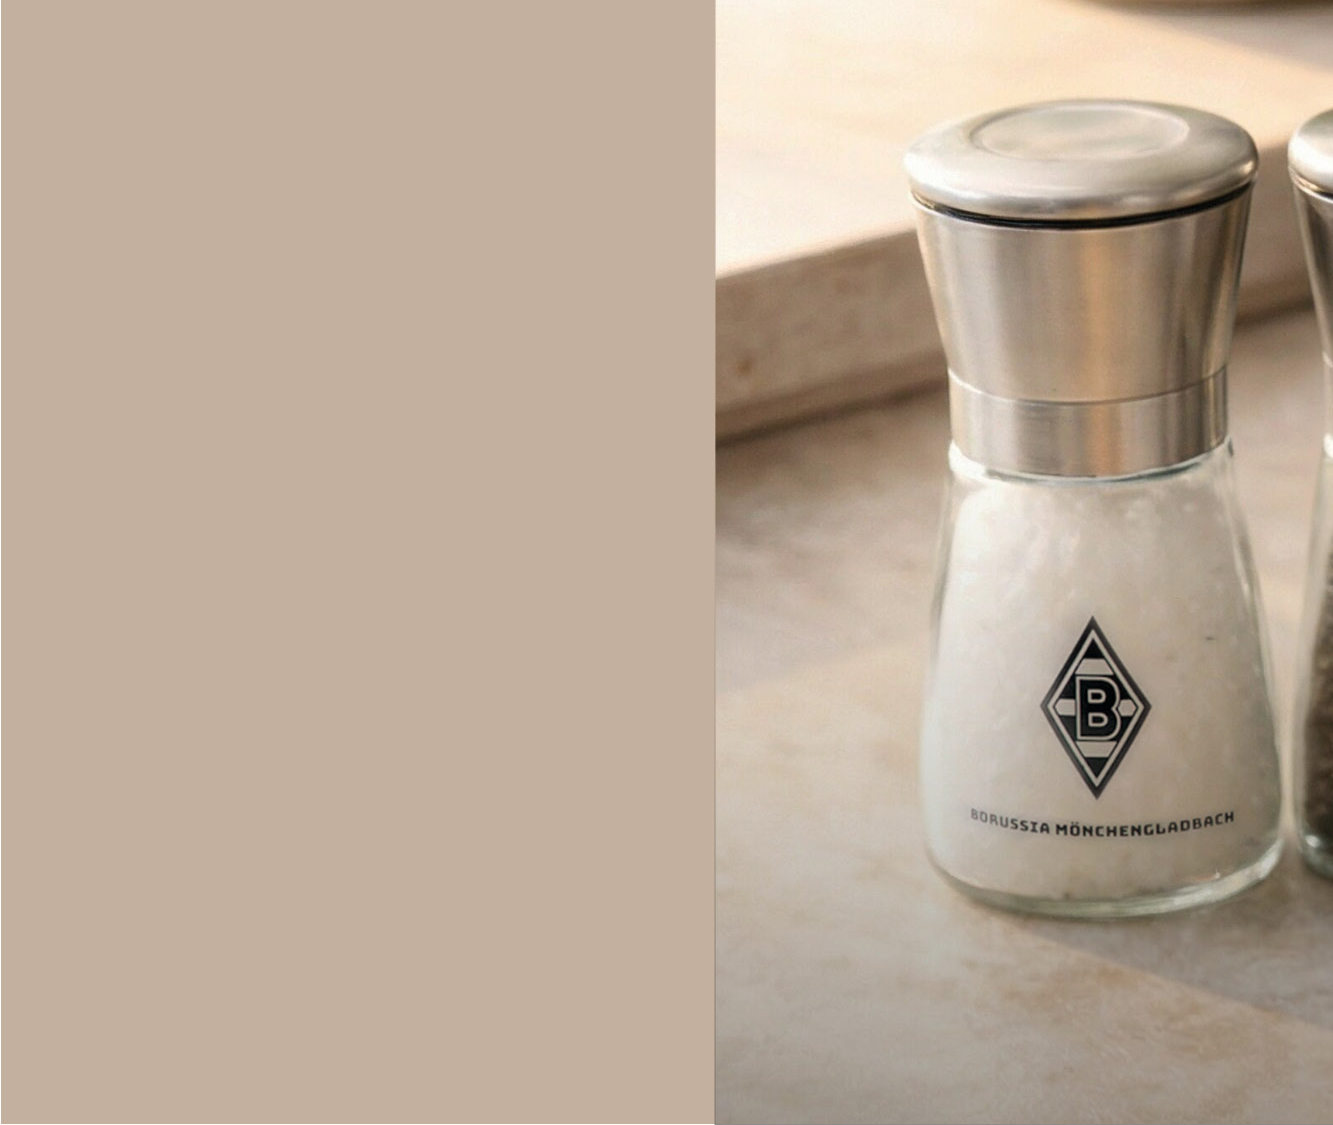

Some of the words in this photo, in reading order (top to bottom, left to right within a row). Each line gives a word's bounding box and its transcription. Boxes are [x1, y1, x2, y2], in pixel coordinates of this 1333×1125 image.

[1075, 675, 1121, 742] B
[970, 808, 1050, 835] BORUSSIA
[1055, 811, 1235, 837] MÖNCHENGLADBACH
